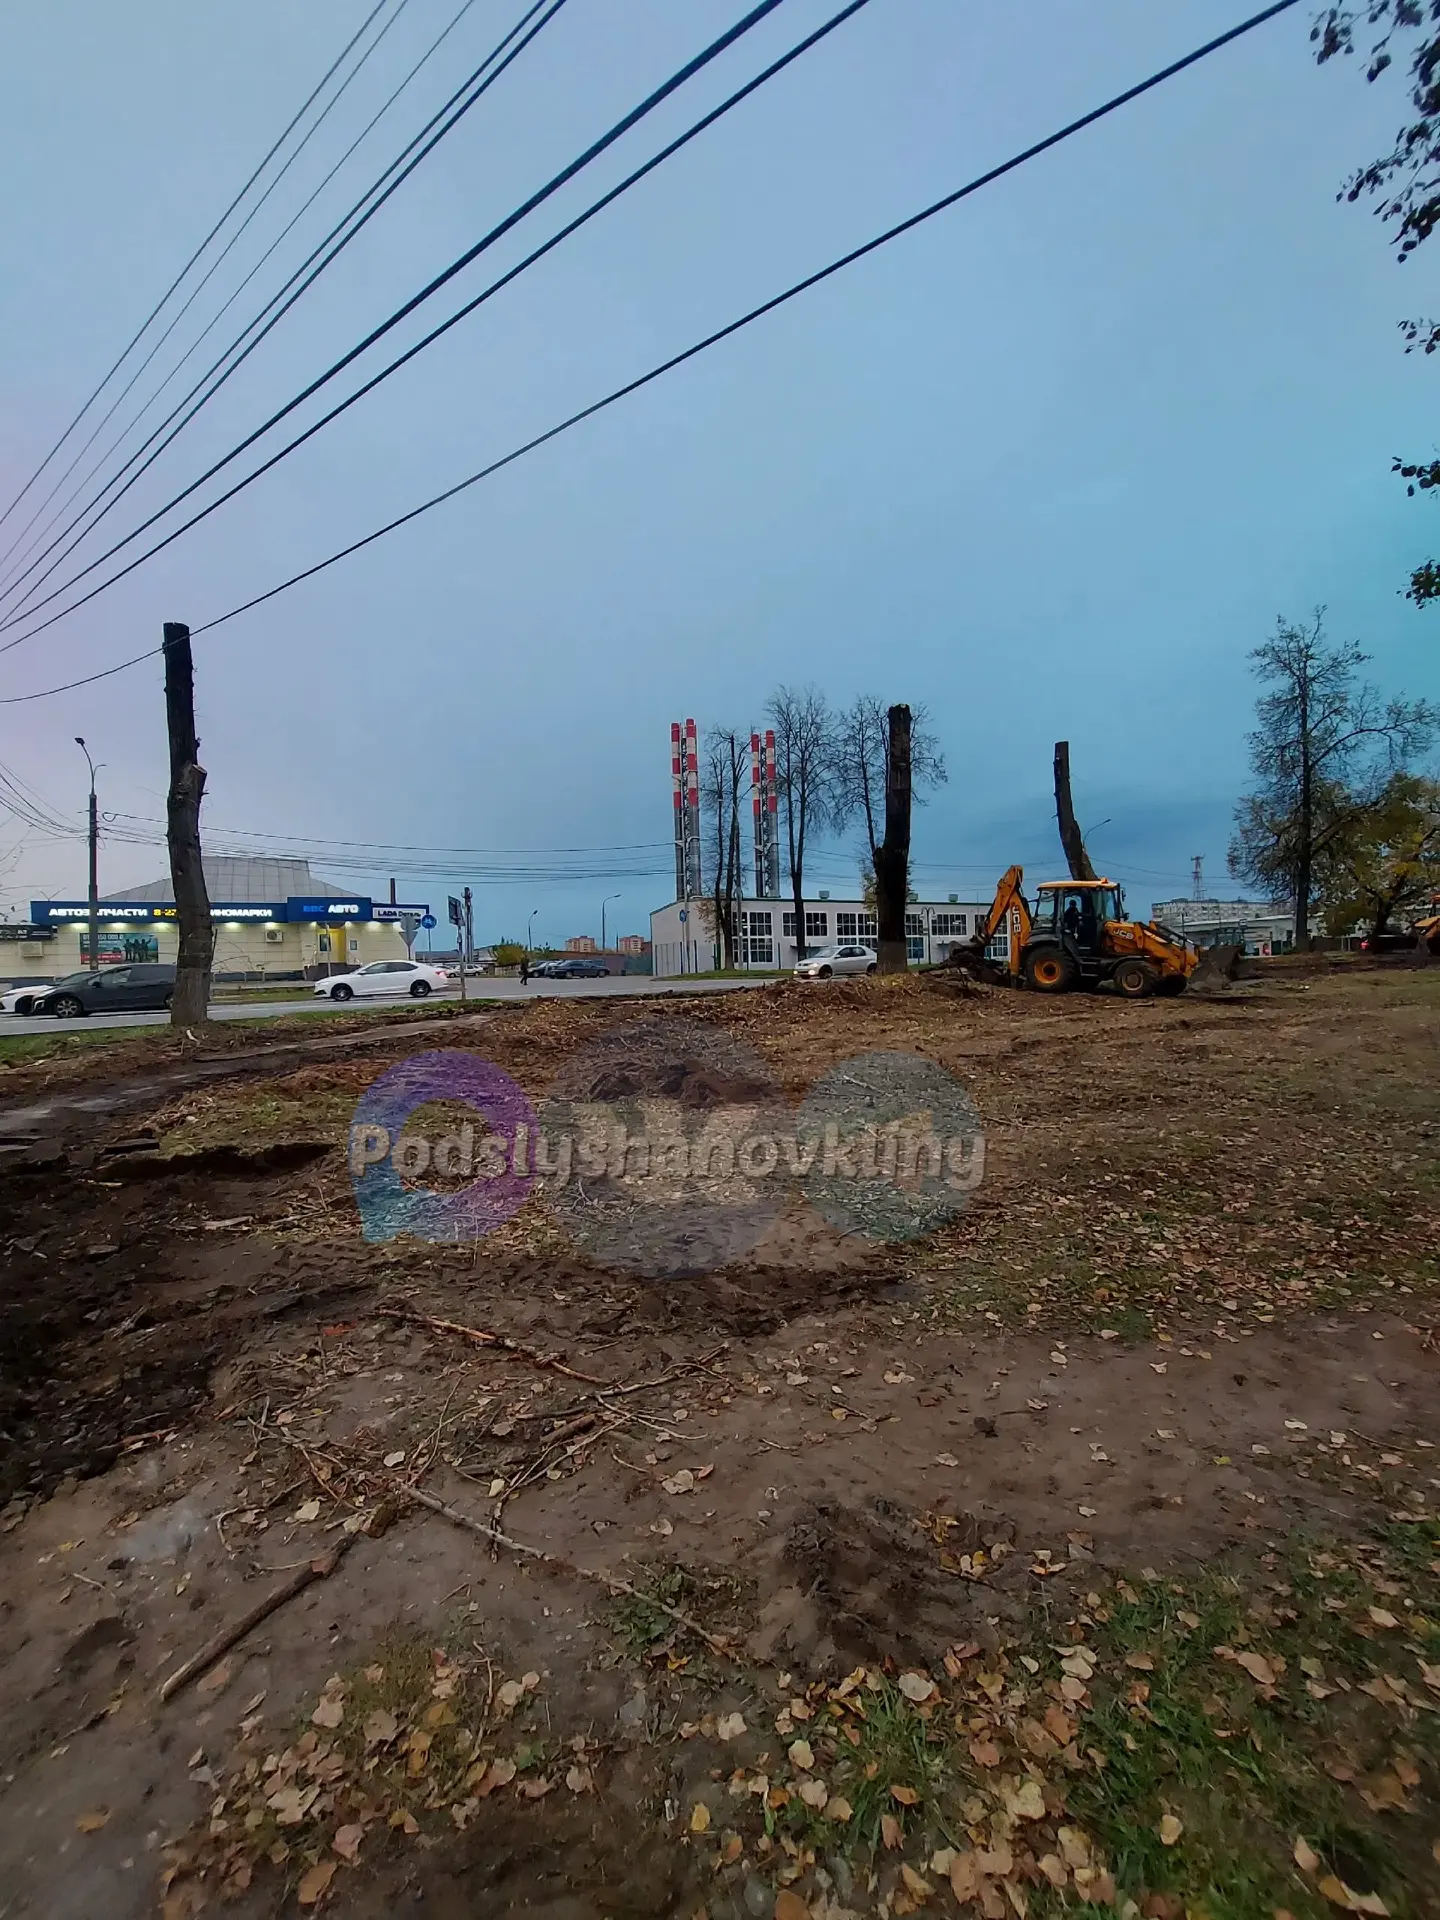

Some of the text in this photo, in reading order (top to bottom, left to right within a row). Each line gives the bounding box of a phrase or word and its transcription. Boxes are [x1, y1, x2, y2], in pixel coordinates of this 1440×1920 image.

[49, 908, 148, 916] АВТОЗПЧАСТИ
[328, 904, 359, 913] АВТО
[1012, 905, 1020, 933] JCB
[1113, 928, 1134, 940] JCB
